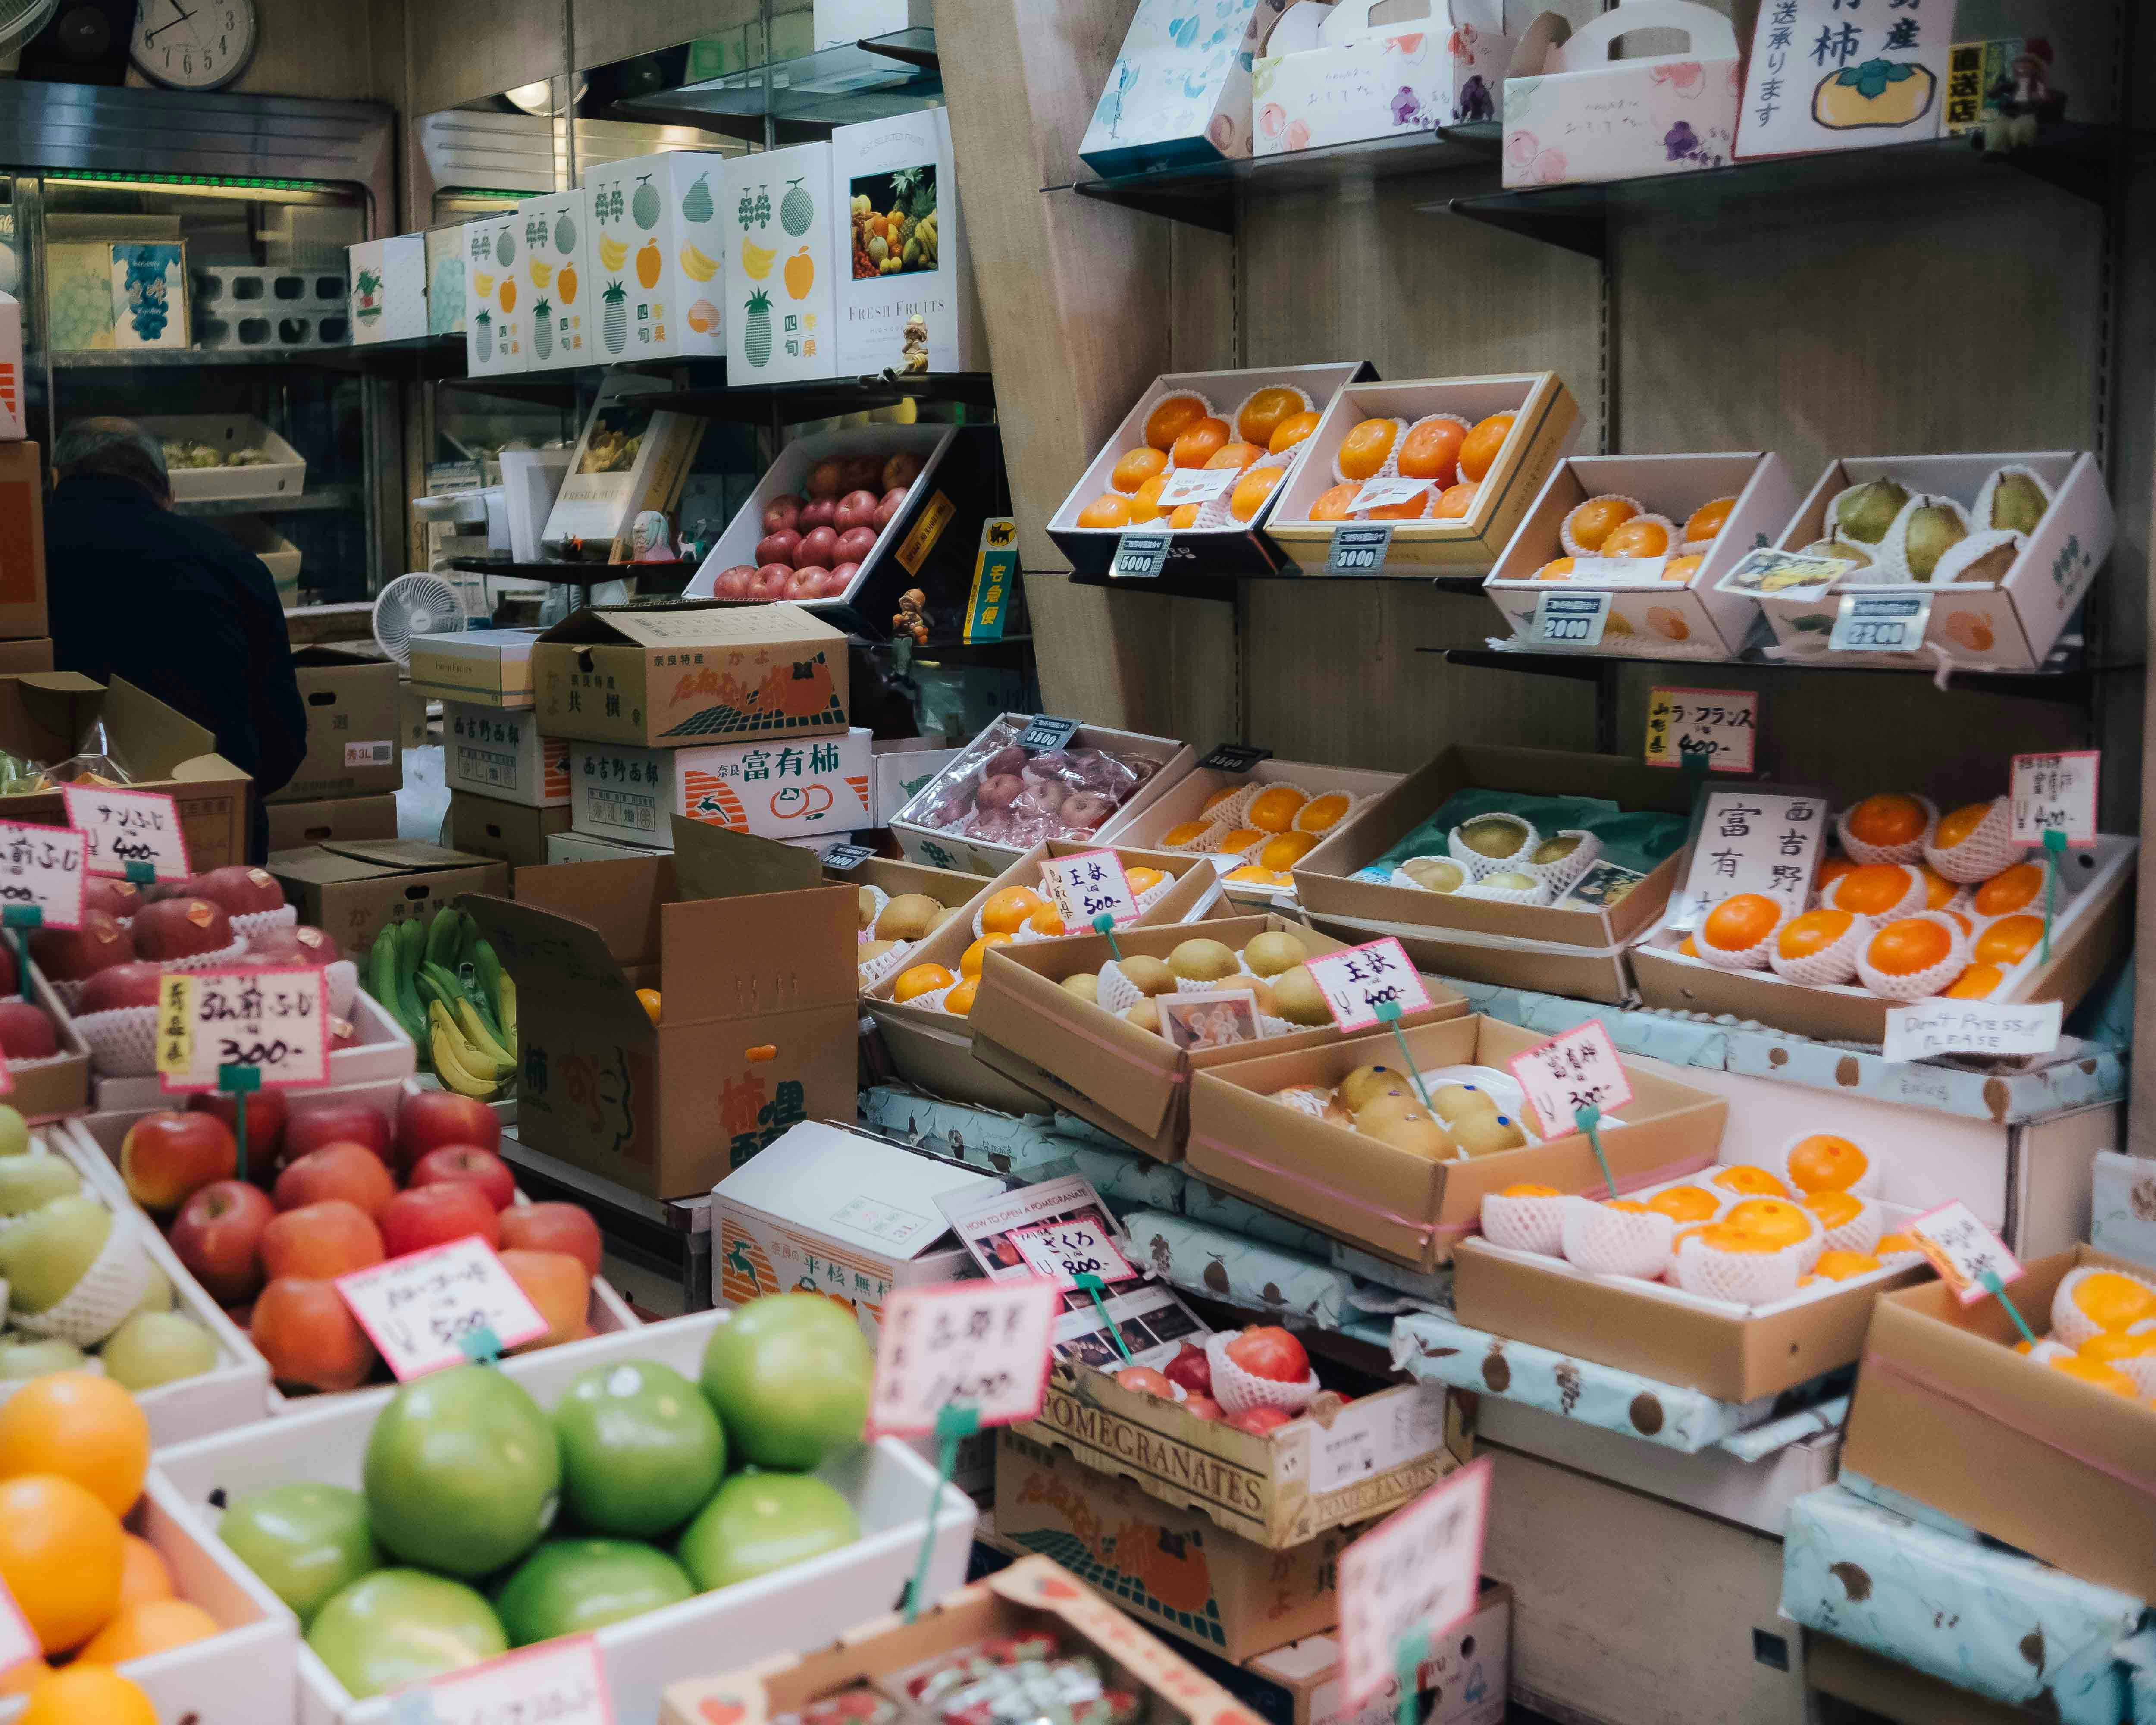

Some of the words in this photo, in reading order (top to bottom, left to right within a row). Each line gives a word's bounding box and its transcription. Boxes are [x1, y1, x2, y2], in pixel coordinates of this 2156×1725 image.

[1809, 0, 1863, 67] 柿
[1881, 0, 1921, 51] 産
[848, 305, 890, 322] FRESH
[895, 299, 946, 317] FRUITS
[1120, 555, 1151, 572] 5000
[654, 653, 704, 666] 奈良特産
[1027, 731, 1056, 745] 3500
[584, 756, 658, 789] 西吉野西部
[718, 763, 740, 777] 奈良
[742, 743, 839, 782] 富有柿
[0, 837, 79, 872] 前ふじ
[1768, 801, 1814, 893] 西吉野
[966, 1218, 985, 1231] HOW
[987, 1215, 1000, 1226] TO
[1002, 1207, 1024, 1221] OPEN
[1032, 1189, 1089, 1211] POMEGRANATE
